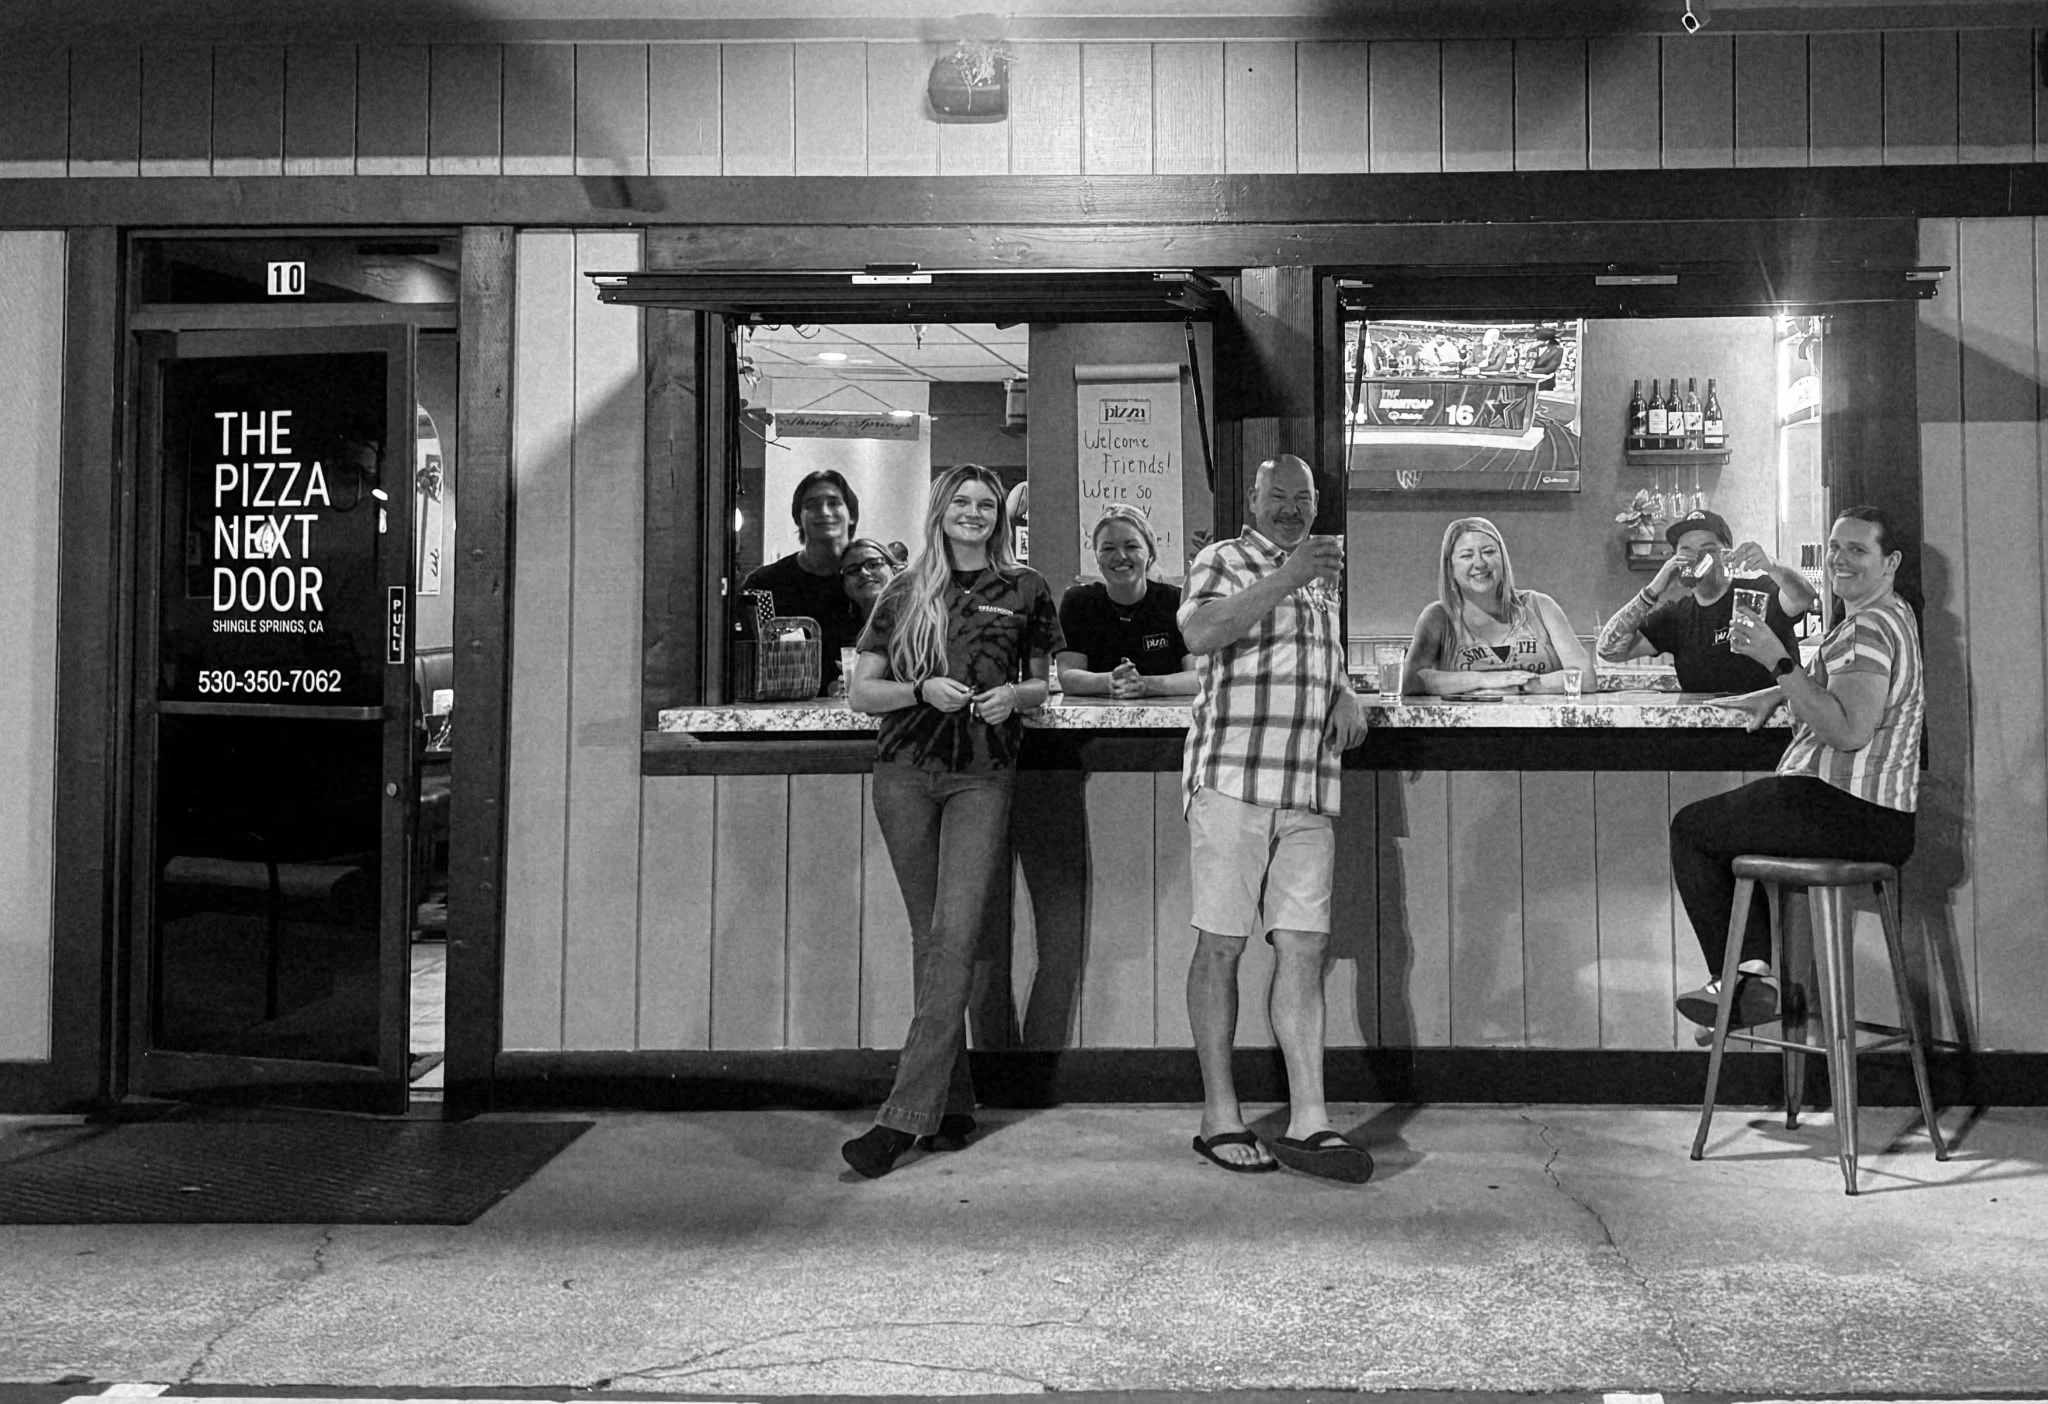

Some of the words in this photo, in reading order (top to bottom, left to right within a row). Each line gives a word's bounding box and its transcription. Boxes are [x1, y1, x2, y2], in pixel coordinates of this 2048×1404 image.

[273, 264, 302, 293] 10
[1104, 405, 1146, 421] pizza
[1446, 405, 1474, 426] 16
[214, 410, 293, 456] THE
[1084, 429, 1150, 450] Welcome
[1103, 452, 1171, 474] Friends!
[215, 461, 331, 508] PIZZA
[1082, 479, 1127, 499] We're
[1136, 485, 1152, 499] so
[214, 514, 319, 560] NEXT
[213, 566, 324, 612] DOOR
[212, 619, 257, 633] SHINGLE
[259, 619, 307, 635] SPRINGS,
[309, 619, 324, 633] CA
[393, 600, 402, 652] PULL
[198, 670, 342, 693] 530-350-7062
